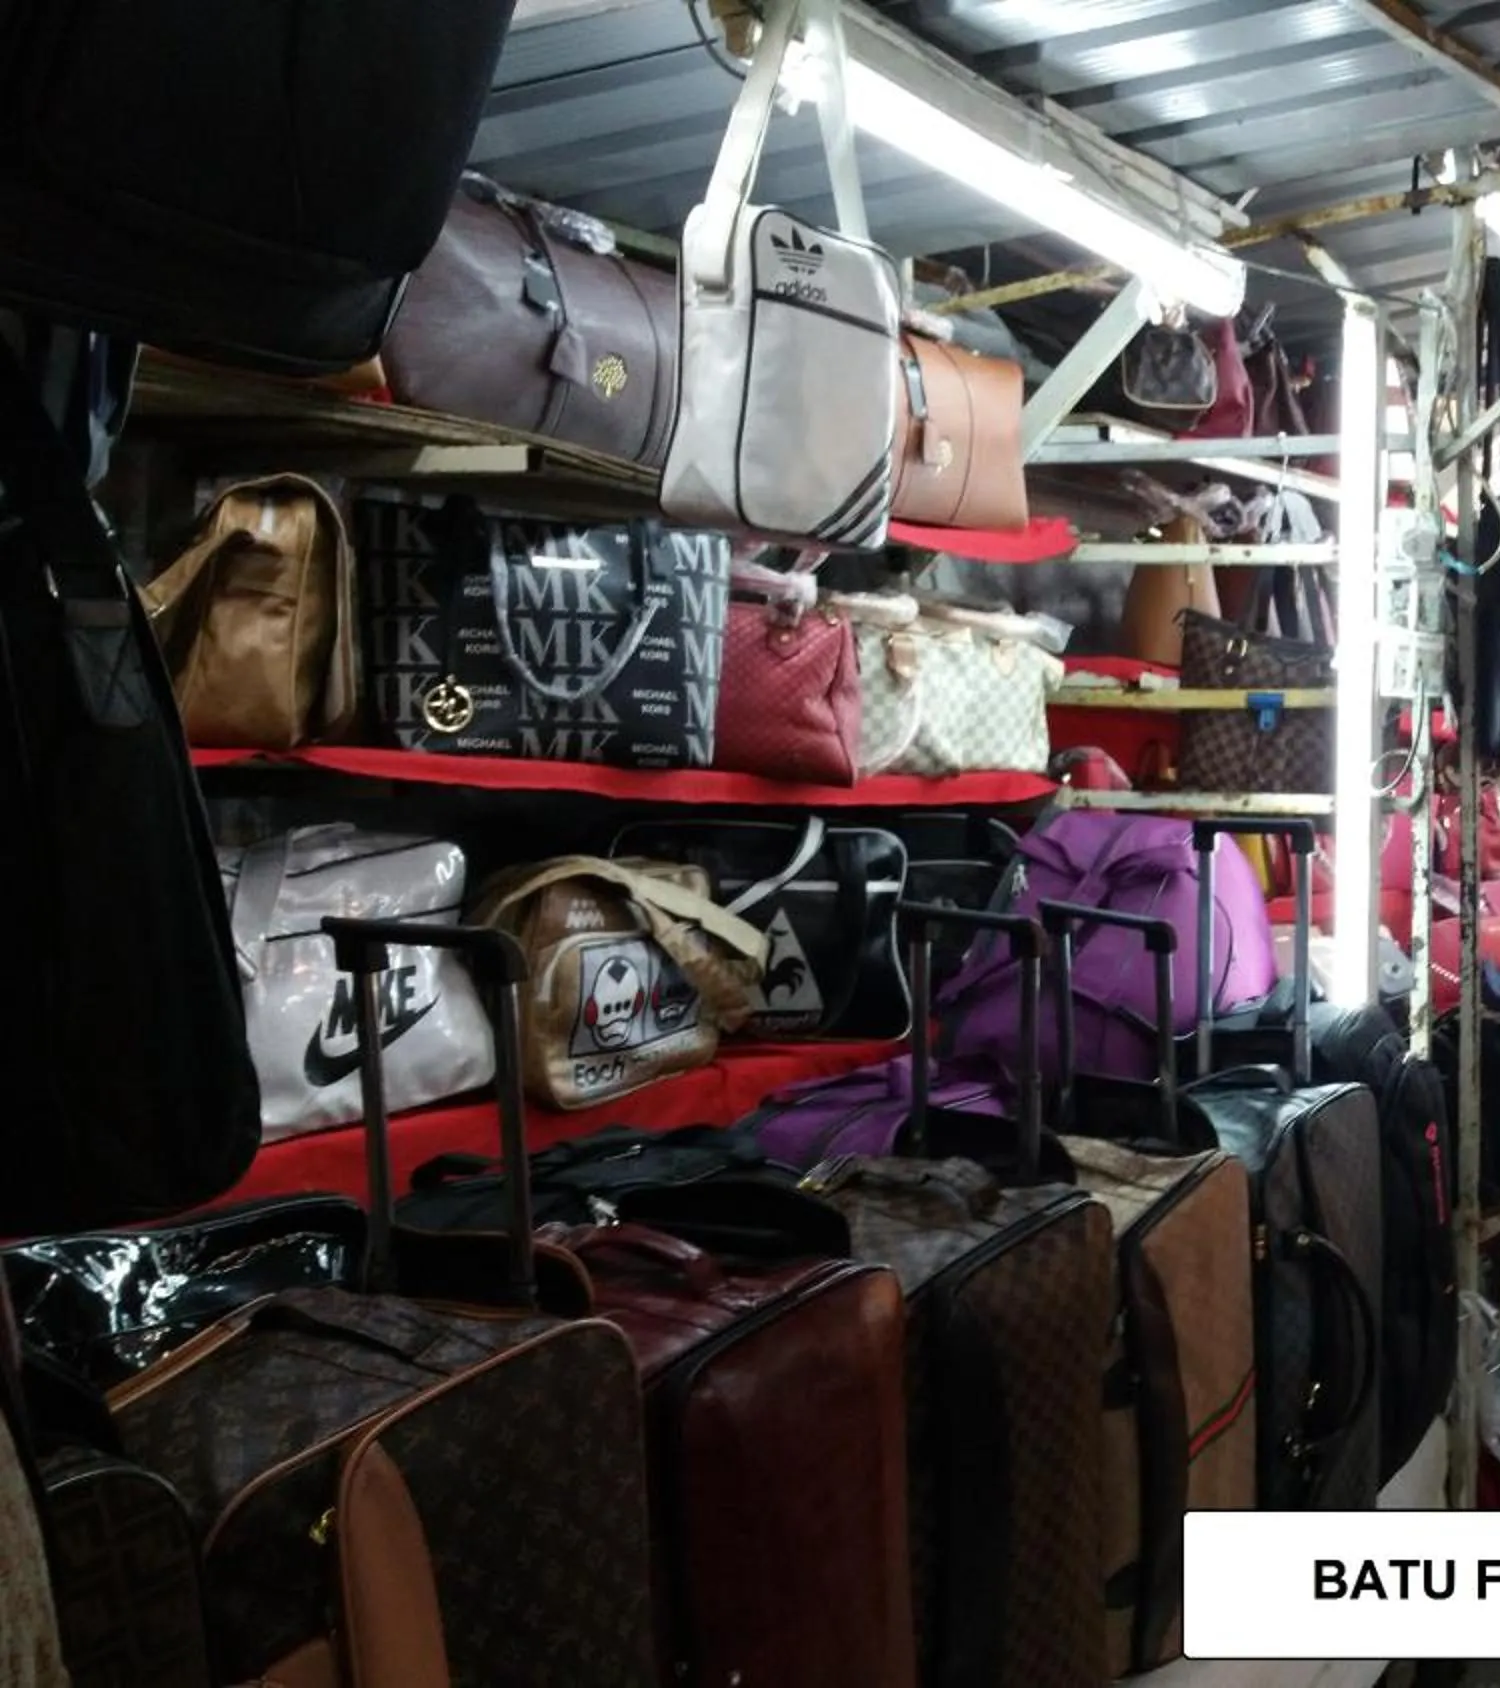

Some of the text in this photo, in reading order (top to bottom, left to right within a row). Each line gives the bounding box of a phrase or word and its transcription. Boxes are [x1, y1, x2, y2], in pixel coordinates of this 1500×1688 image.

[775, 281, 828, 302] adidas
[513, 563, 617, 613] MK
[372, 615, 440, 665] K
[514, 618, 619, 668] MK
[633, 689, 678, 702] MICHAEL
[457, 738, 512, 750] MICHAEL
[324, 965, 417, 1040] NKE
